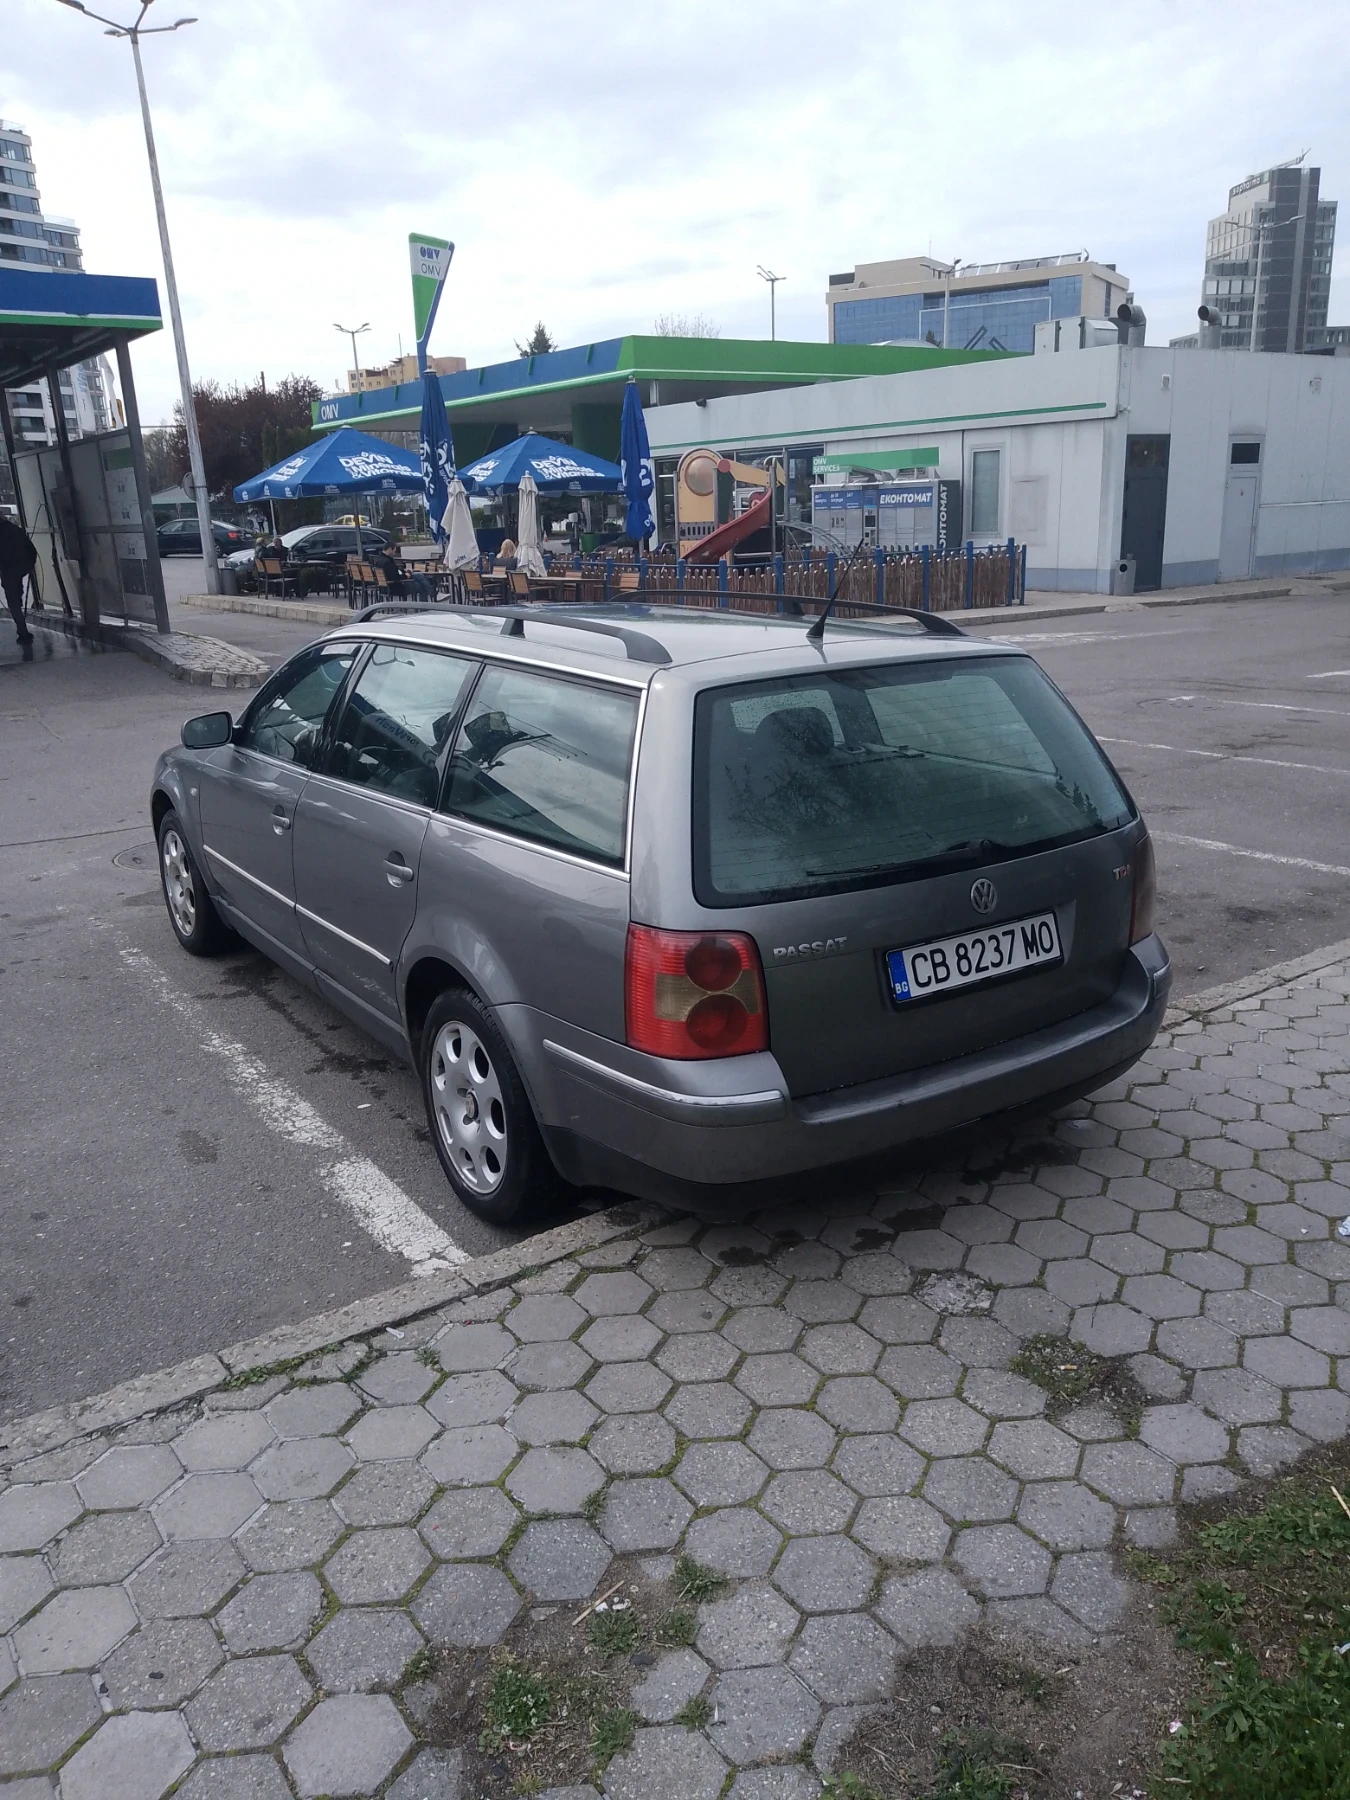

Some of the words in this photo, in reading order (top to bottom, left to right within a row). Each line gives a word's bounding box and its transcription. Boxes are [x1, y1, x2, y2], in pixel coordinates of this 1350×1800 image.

[420, 246, 441, 260] OMV
[421, 263, 441, 276] OMV
[321, 403, 339, 420] OMV
[339, 452, 393, 467] DEVIN
[531, 455, 578, 469] DEVIN
[813, 458, 827, 466] OMV
[351, 462, 412, 474] Minerals
[542, 466, 595, 475] Minerals
[813, 465, 840, 473] SERVICES
[880, 492, 932, 504] ЕКОНТОМАТ
[1112, 864, 1131, 880] TDI
[773, 936, 847, 959] PASSAT
[911, 948, 951, 988] CB
[954, 928, 1016, 977] 8237
[1020, 920, 1054, 960] MO
[895, 981, 908, 994] BG
